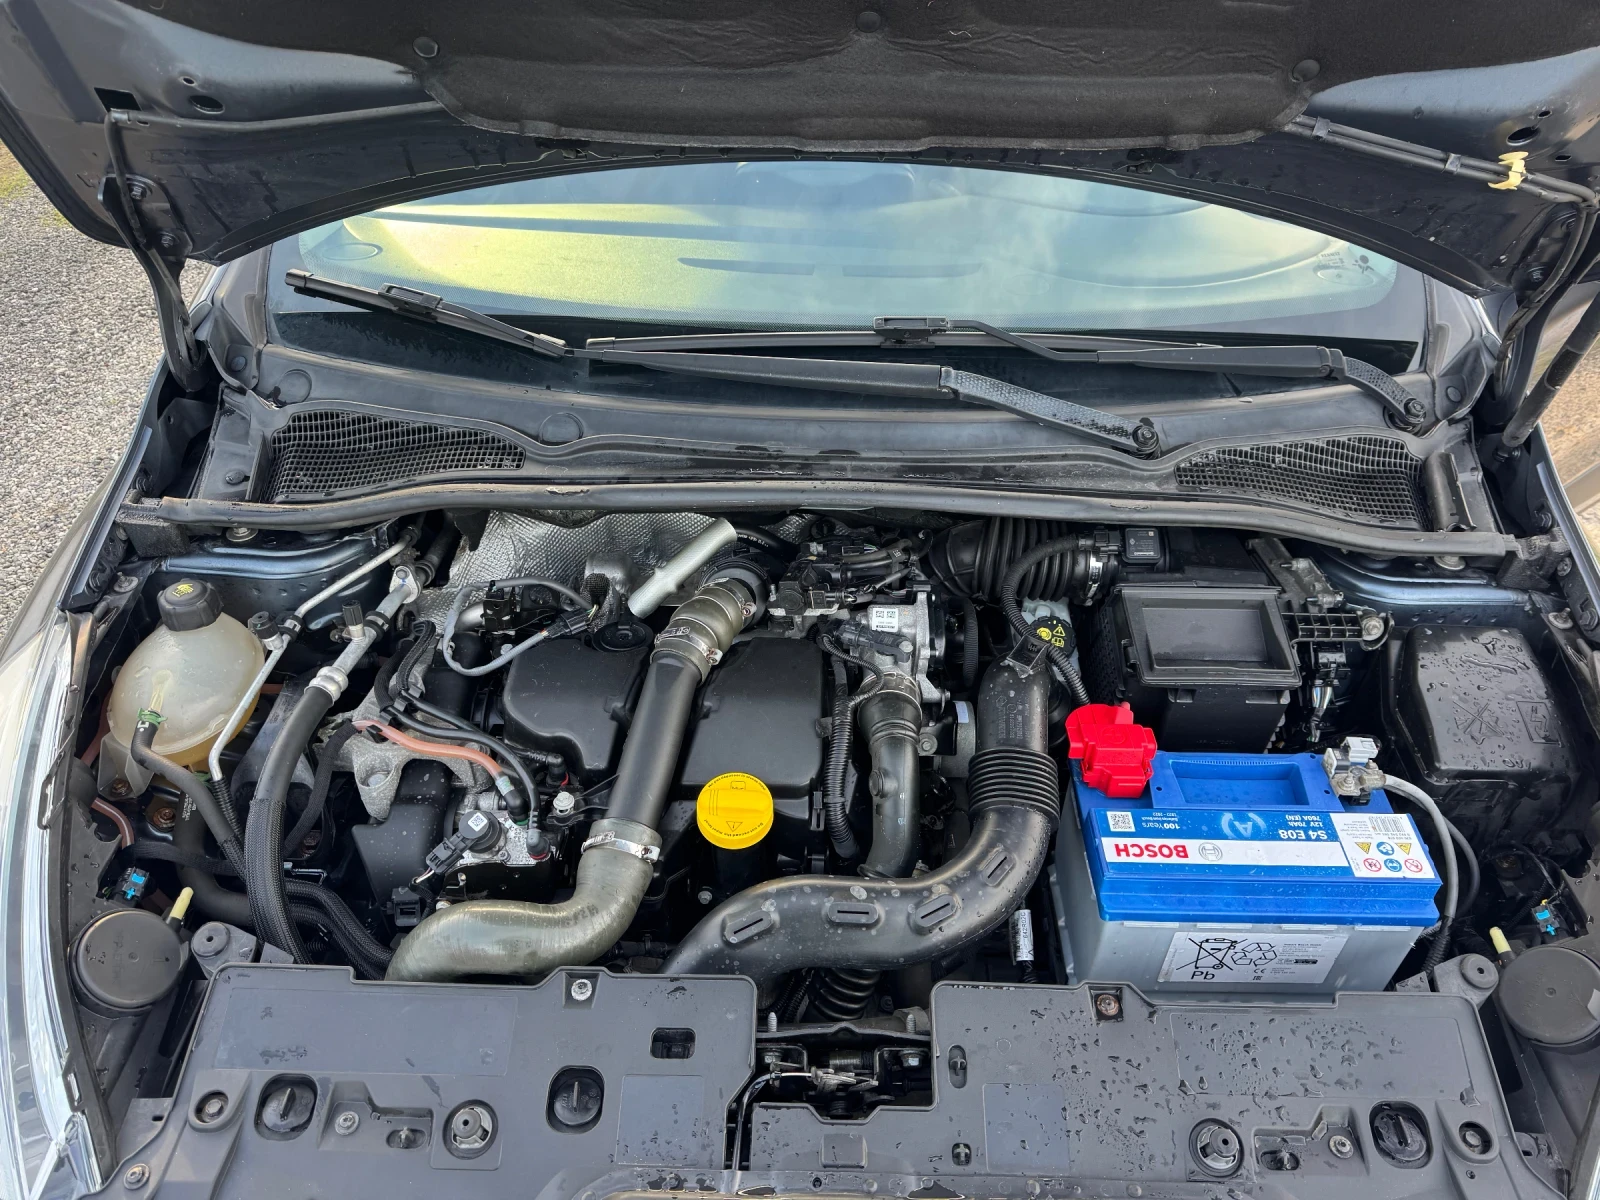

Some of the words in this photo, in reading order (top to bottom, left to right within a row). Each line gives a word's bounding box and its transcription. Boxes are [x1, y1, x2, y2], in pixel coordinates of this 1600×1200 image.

[1278, 829, 1305, 839] E08
[1308, 829, 1328, 840] S4
[1114, 844, 1189, 859] BOSCH
[1190, 971, 1216, 980] Pb
